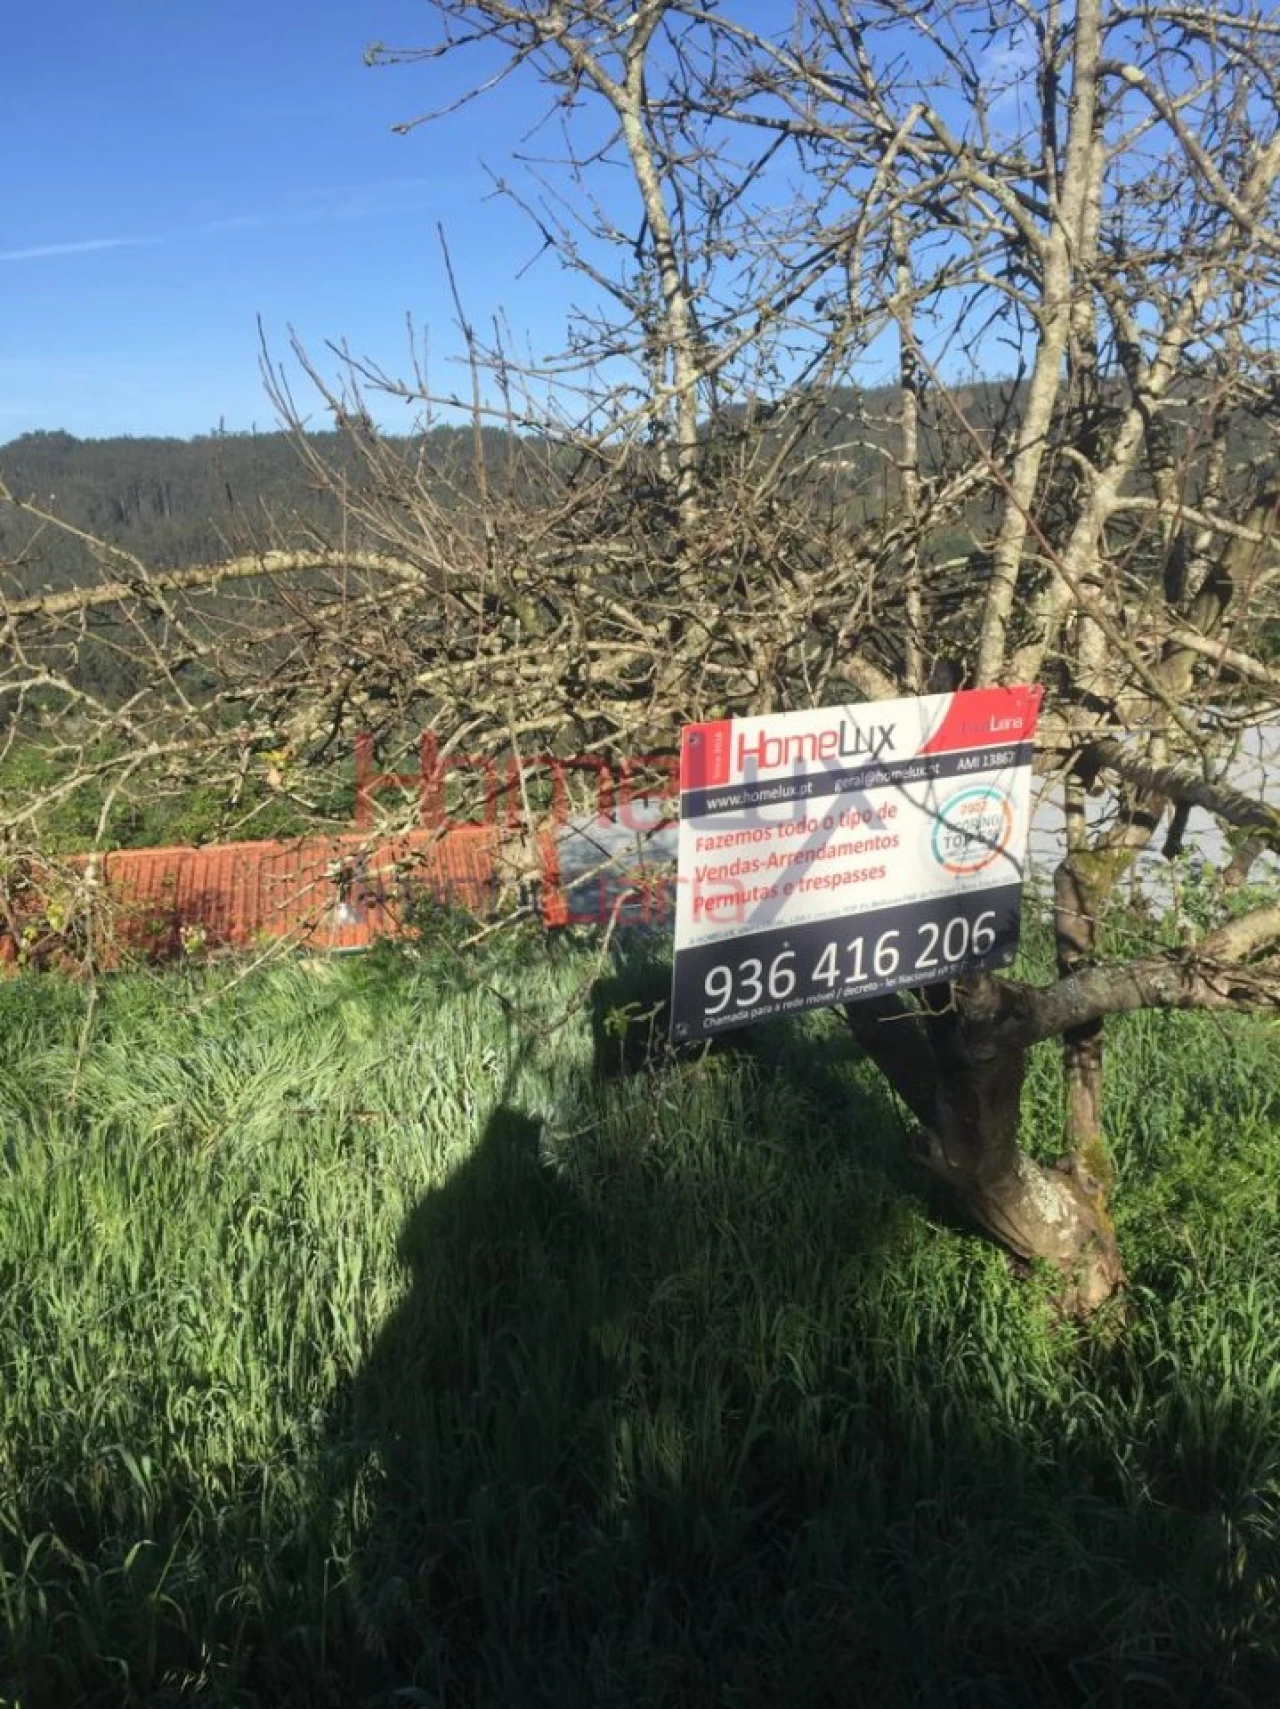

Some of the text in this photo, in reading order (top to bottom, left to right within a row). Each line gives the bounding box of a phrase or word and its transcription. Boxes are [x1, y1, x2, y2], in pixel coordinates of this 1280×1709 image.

[738, 720, 896, 772] HomeLux
[706, 782, 813, 809] www.homelux.pt
[956, 756, 980, 771] AMI
[695, 801, 898, 853] Fazemos todo o tipo de
[694, 834, 900, 882] Vendas-Arrendamentos
[693, 864, 886, 914] Permutas e trespasses
[704, 910, 996, 1014] 936 416 206
[702, 1009, 749, 1028] Chamada
[751, 1005, 772, 1020] para
[783, 997, 803, 1011] rede
